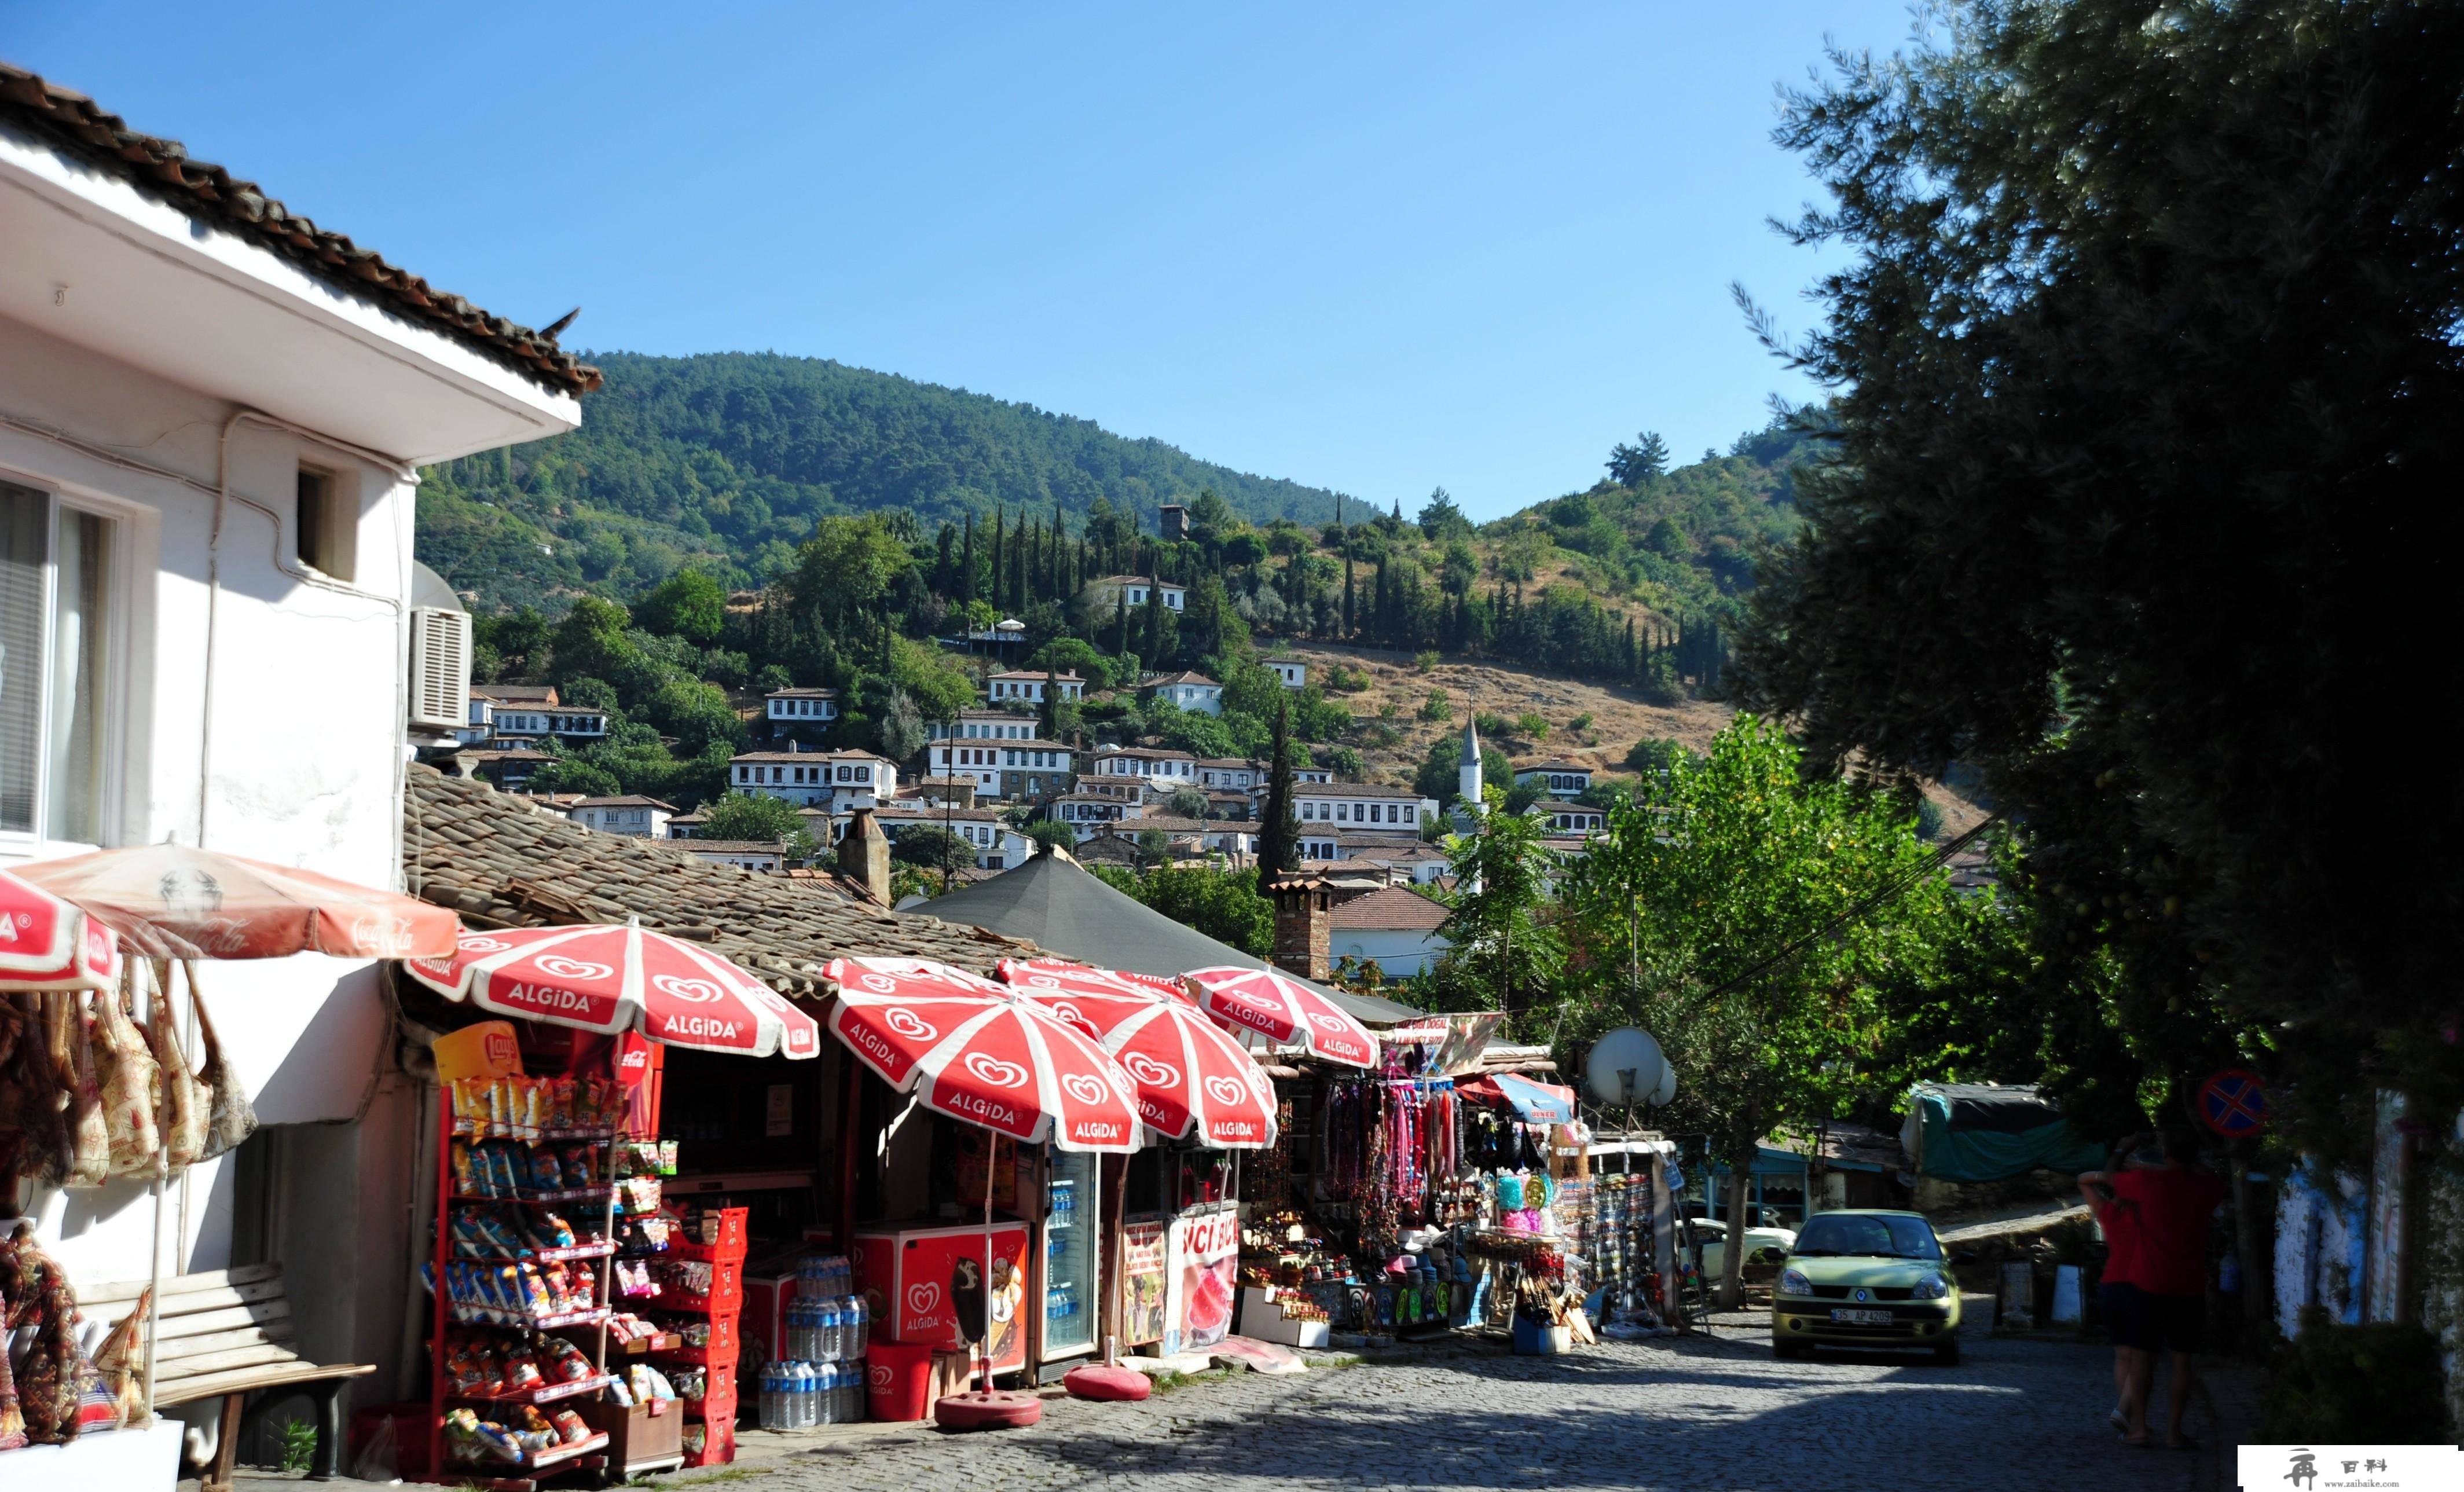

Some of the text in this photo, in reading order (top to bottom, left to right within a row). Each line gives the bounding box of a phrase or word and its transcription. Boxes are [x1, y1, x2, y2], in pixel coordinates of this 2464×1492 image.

[1837, 1310, 1890, 1321] 35 AP 4209
